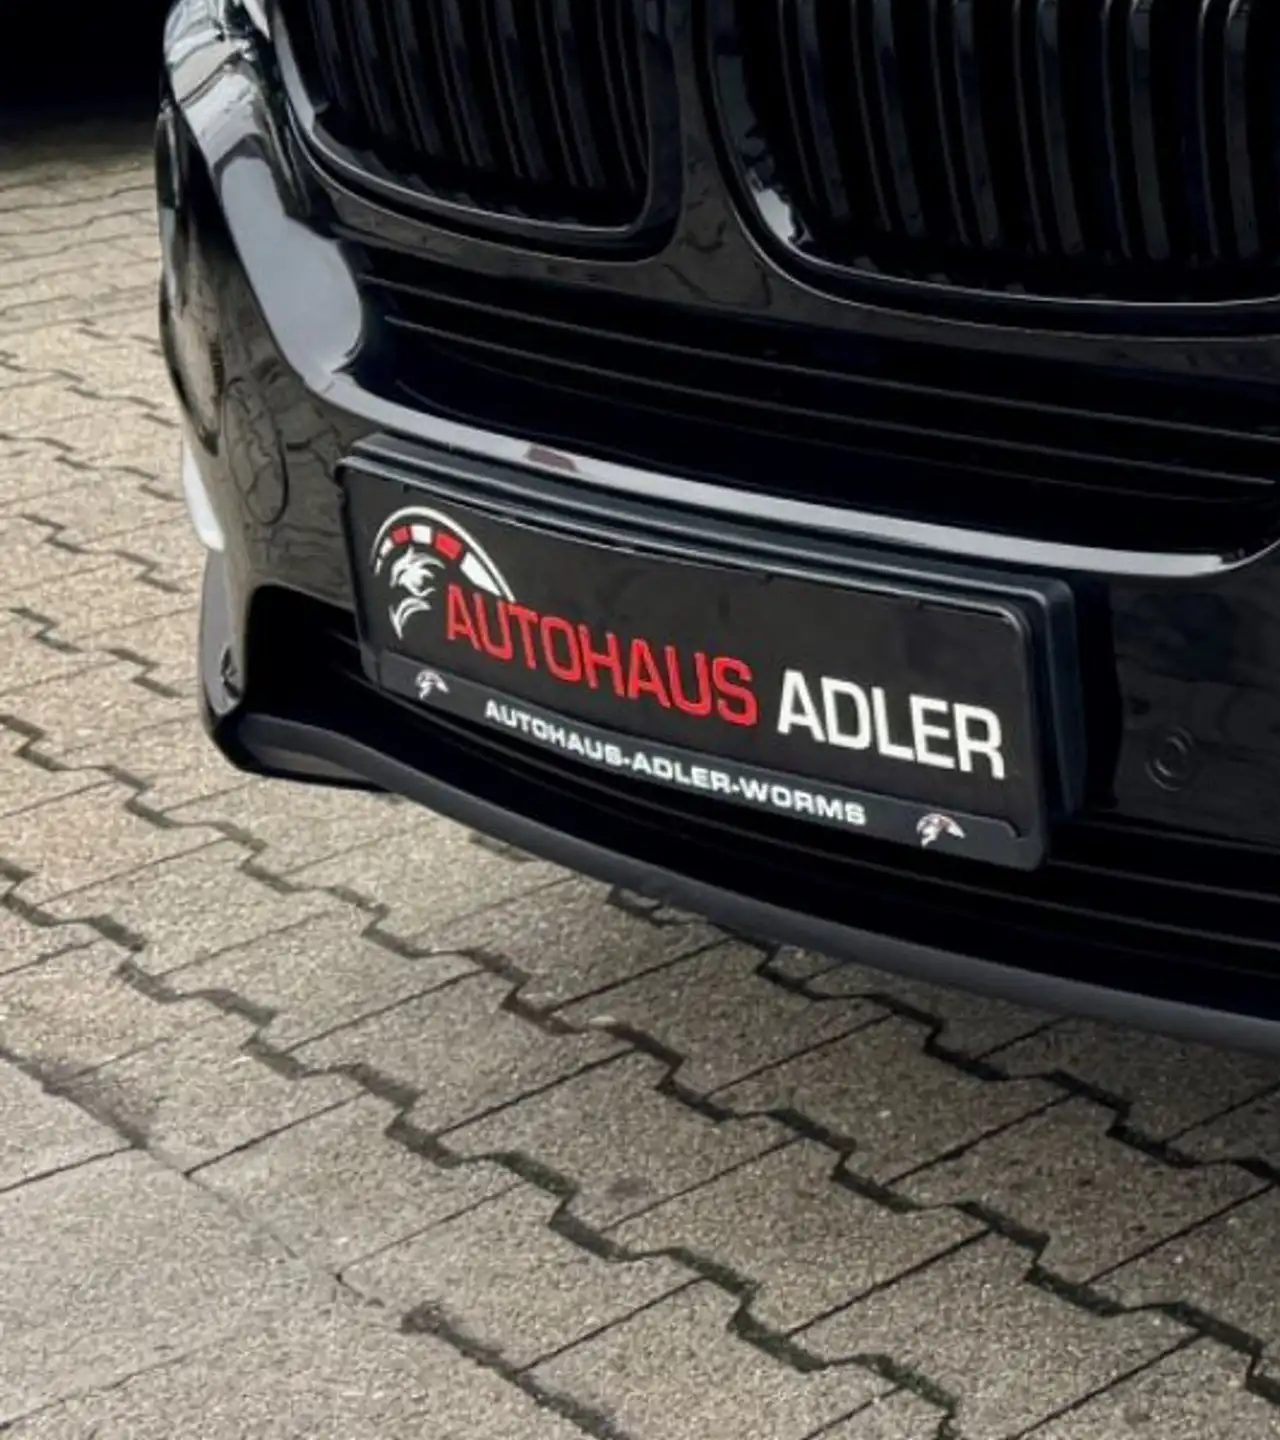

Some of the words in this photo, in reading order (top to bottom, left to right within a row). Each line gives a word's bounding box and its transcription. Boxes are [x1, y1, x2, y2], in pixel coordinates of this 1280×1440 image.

[445, 582, 759, 726] AUTOHAUS
[776, 669, 1007, 779] ADLER
[484, 698, 868, 826] AUTOHAUS-ADLER-WORMS
